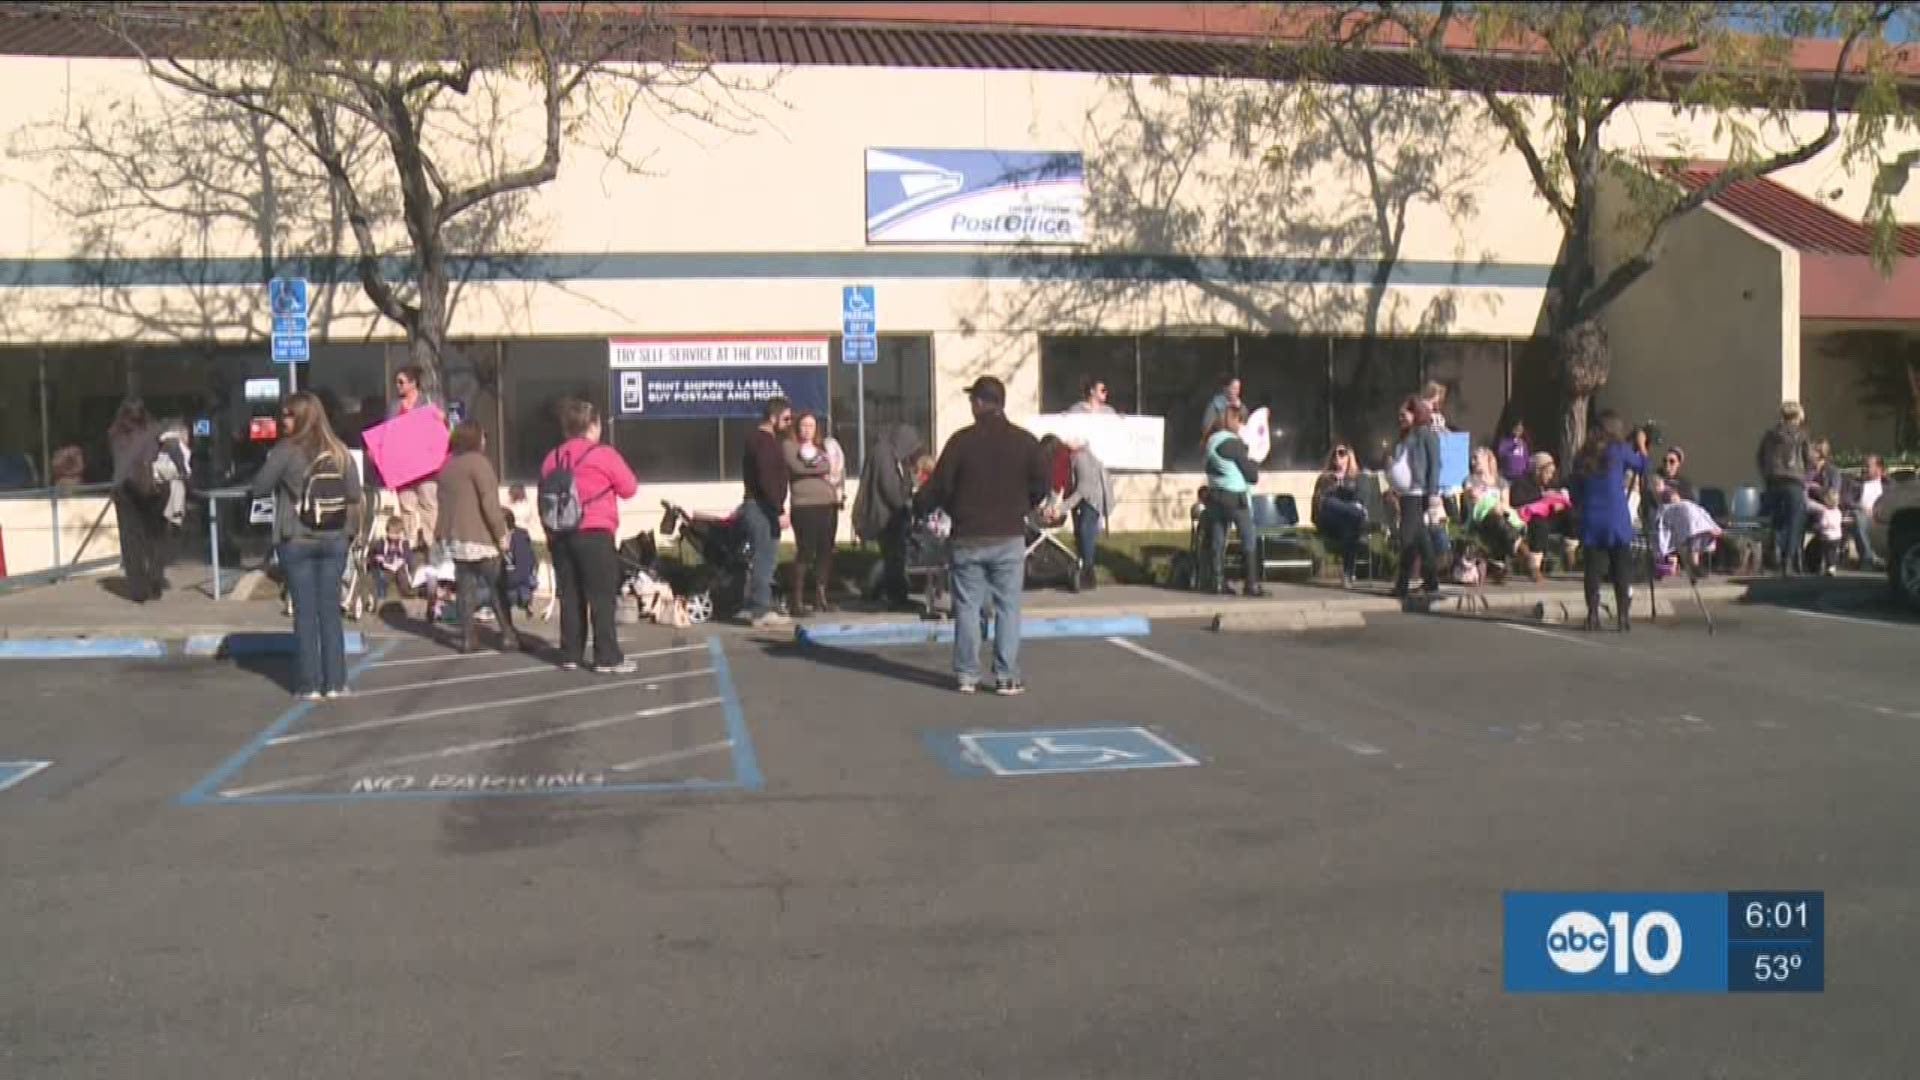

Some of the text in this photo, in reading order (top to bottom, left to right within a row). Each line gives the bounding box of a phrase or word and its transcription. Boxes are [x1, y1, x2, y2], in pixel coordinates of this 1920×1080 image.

[617, 345, 821, 361] TRY SELF-SERVICE AT THE POST OFFICE
[648, 379, 782, 392] PRINT SHIPPING LABELS,
[648, 391, 671, 402] BUY
[674, 391, 723, 401] POSTAGE
[727, 390, 751, 401] AND
[351, 773, 604, 793] NO PARKING
